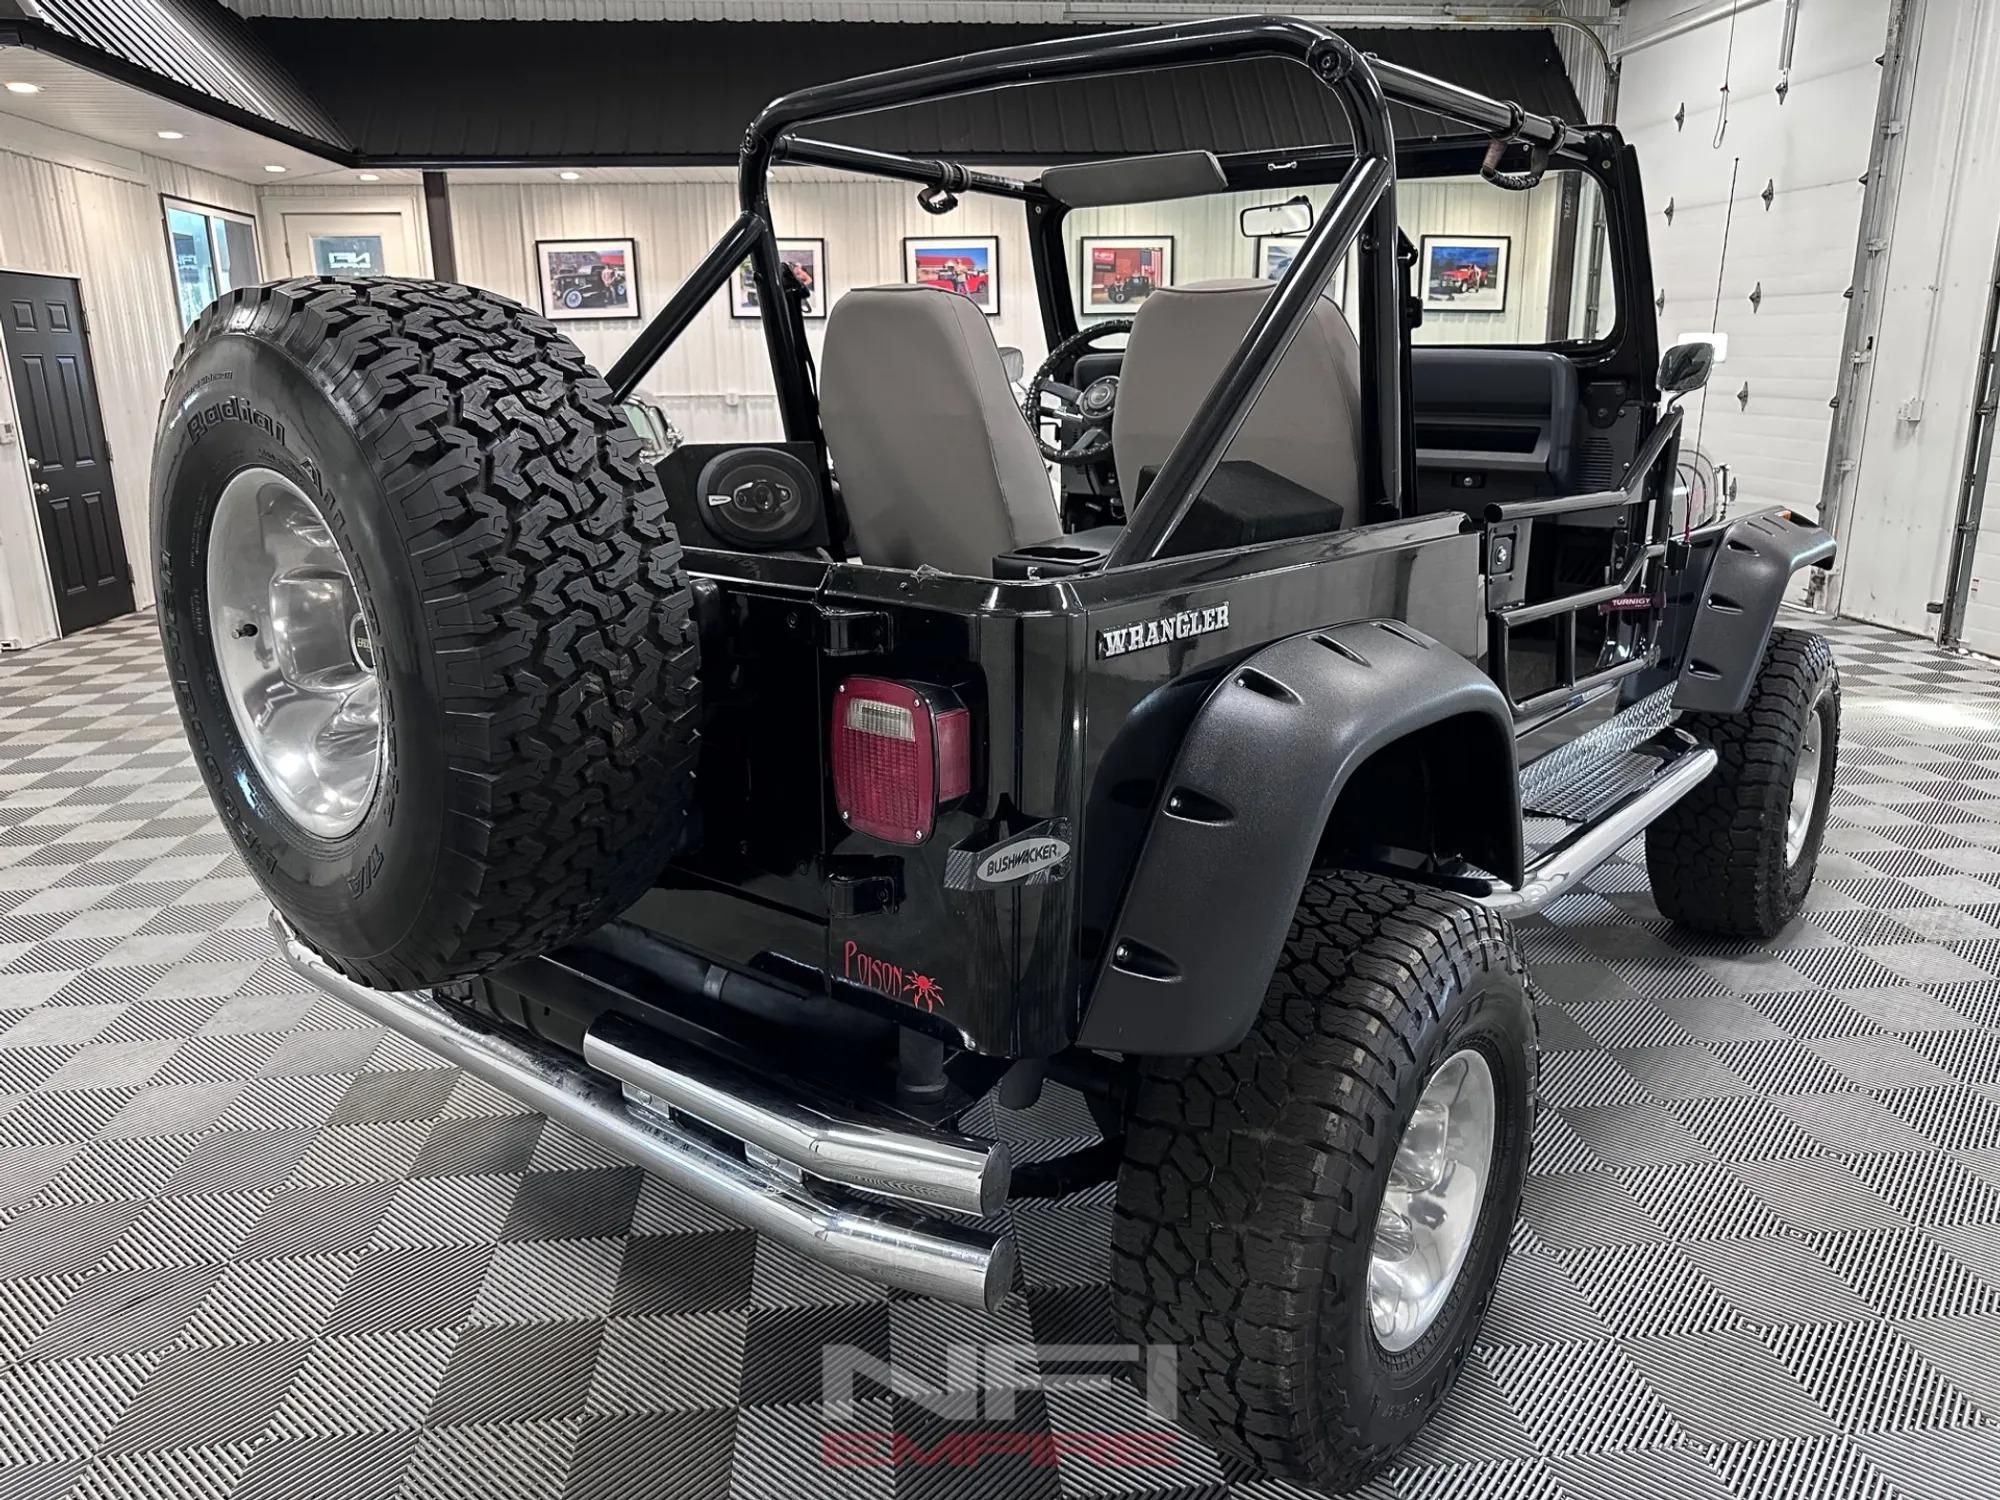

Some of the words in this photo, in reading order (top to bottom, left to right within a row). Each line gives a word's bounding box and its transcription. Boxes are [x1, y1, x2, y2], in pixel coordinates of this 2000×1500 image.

[187, 395, 286, 446] Radial
[1612, 597, 1651, 607] TURNIGY
[1102, 603, 1230, 657] WRANGLER
[986, 843, 1058, 877] BUSHWACKER
